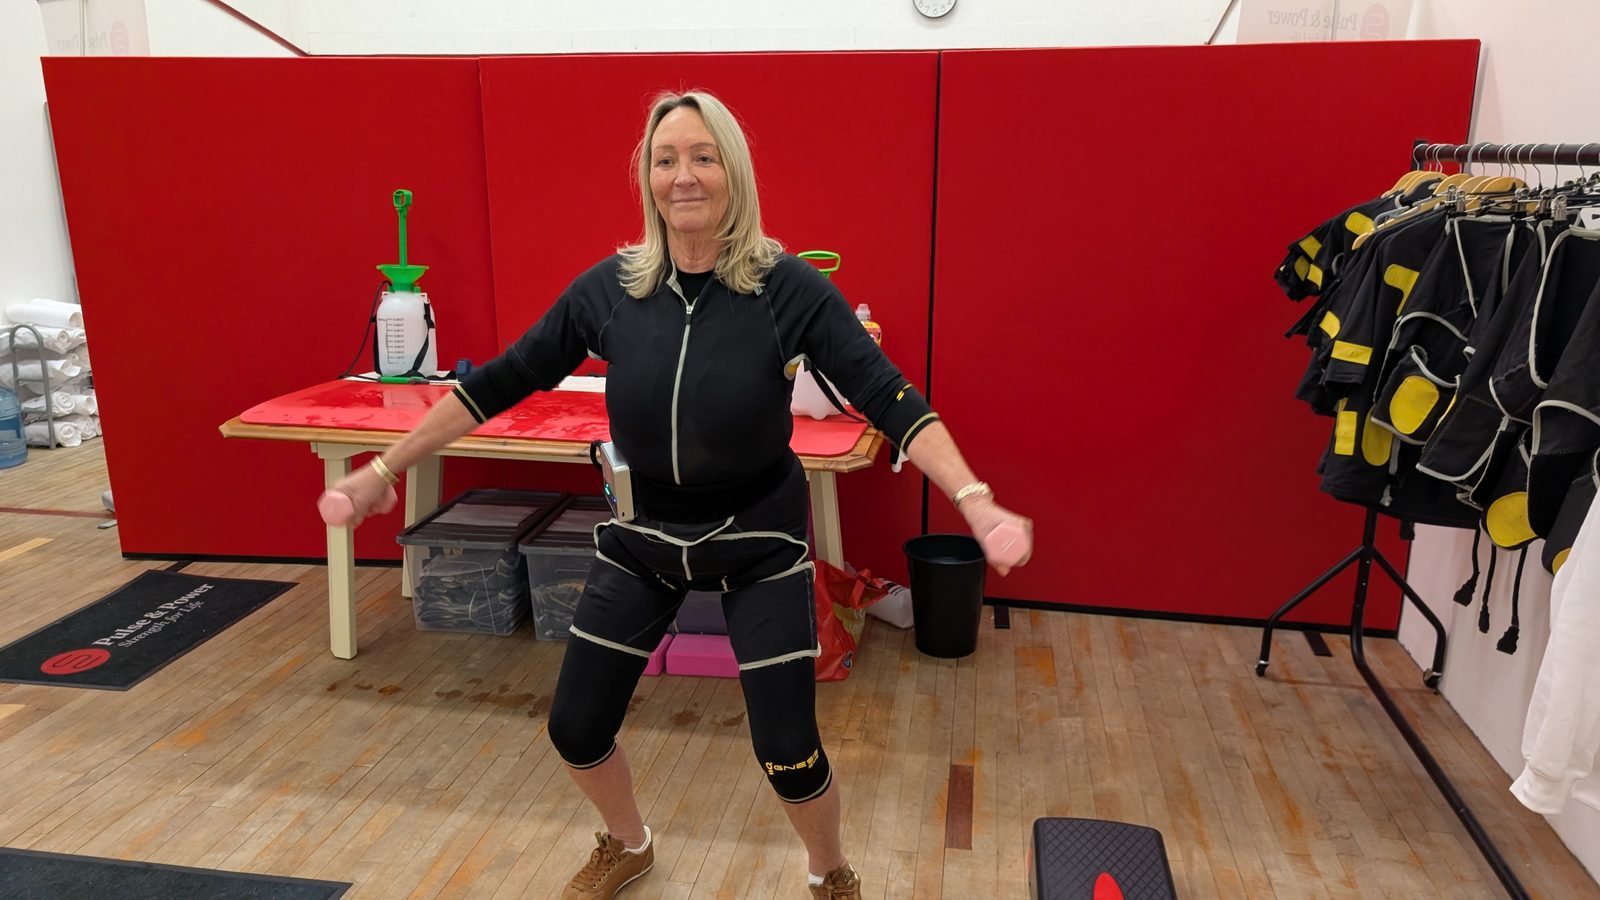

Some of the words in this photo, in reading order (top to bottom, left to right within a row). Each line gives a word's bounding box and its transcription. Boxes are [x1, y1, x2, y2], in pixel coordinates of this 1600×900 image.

[91, 619, 152, 647] Pulse
[144, 610, 169, 619] &
[157, 584, 215, 610] Power
[118, 621, 170, 647] Strength
[165, 612, 183, 622] for
